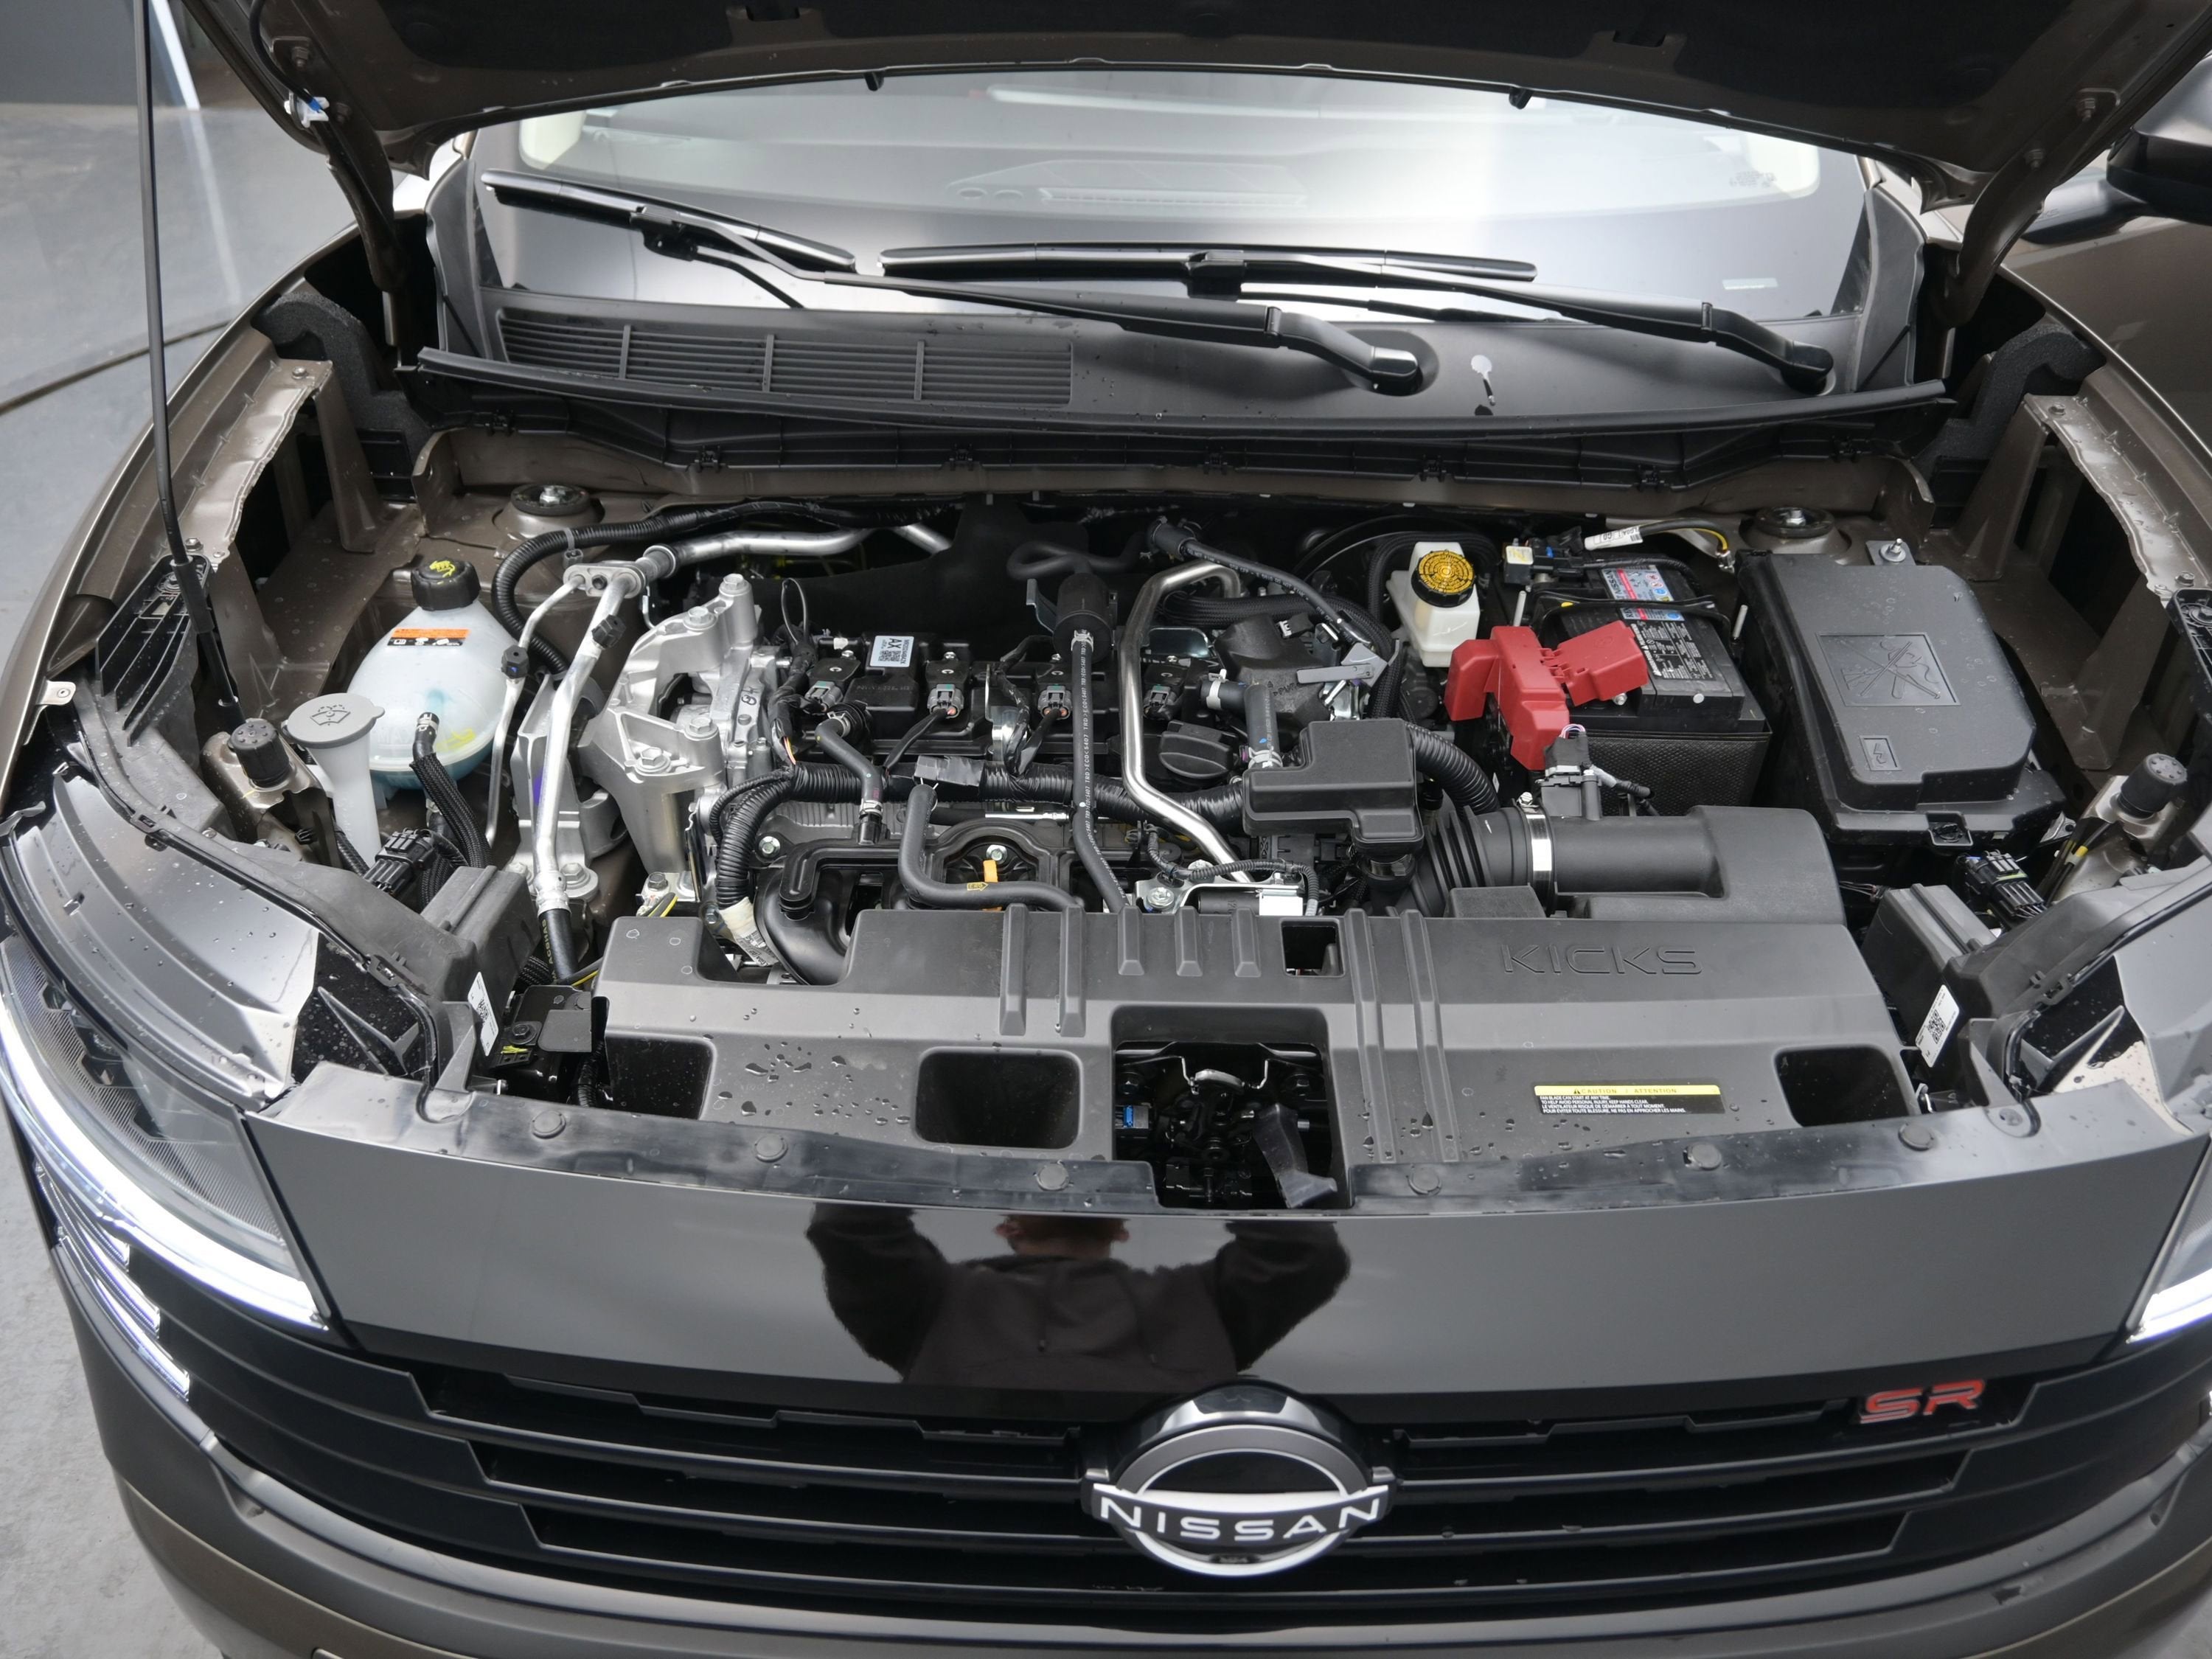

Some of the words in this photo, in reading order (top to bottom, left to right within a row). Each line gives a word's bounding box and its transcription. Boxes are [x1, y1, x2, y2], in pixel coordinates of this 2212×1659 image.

[1604, 569, 1624, 597] NISSAN
[888, 638, 902, 649] AX
[1500, 944, 1702, 975] KICKS
[1858, 1379, 1987, 1424] SR
[1100, 1496, 1381, 1543] NISSAN
